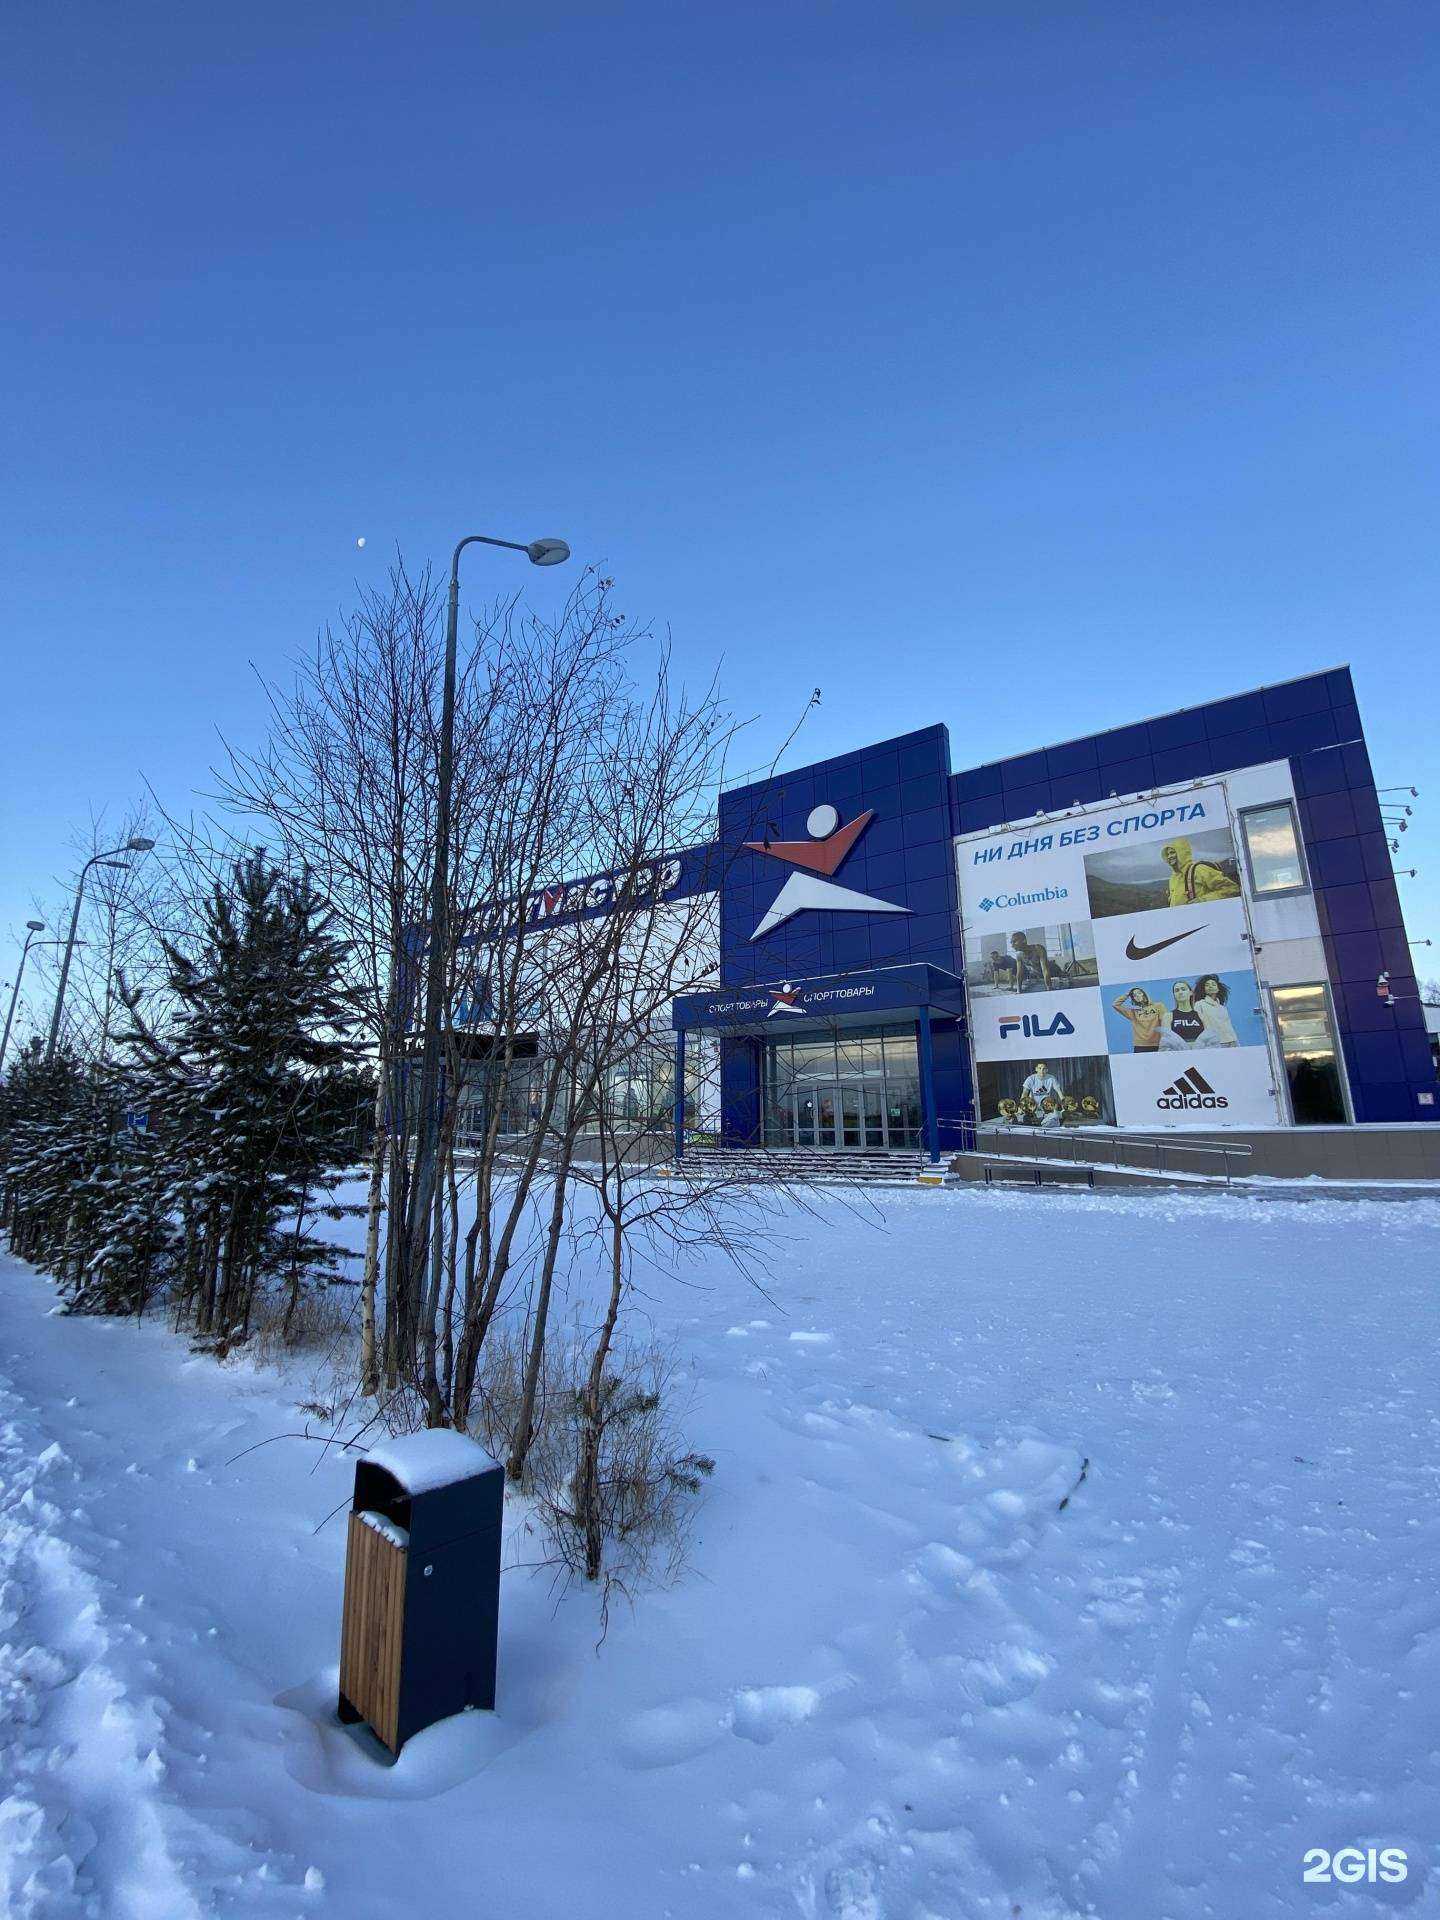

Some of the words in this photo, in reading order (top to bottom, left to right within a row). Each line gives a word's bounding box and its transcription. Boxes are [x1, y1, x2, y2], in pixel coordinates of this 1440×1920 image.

[973, 845, 1003, 865] НИ
[1007, 834, 1054, 860] ДНЯ
[1059, 825, 1101, 848] БЕЗ
[1106, 802, 1206, 836] СПОРТА
[994, 886, 1069, 909] Columbia
[803, 986, 875, 1002] СПОРТТОВАРЫ
[998, 1012, 1075, 1039] FILA
[1174, 1019, 1200, 1027] FILA
[1156, 1093, 1229, 1109] adidas
